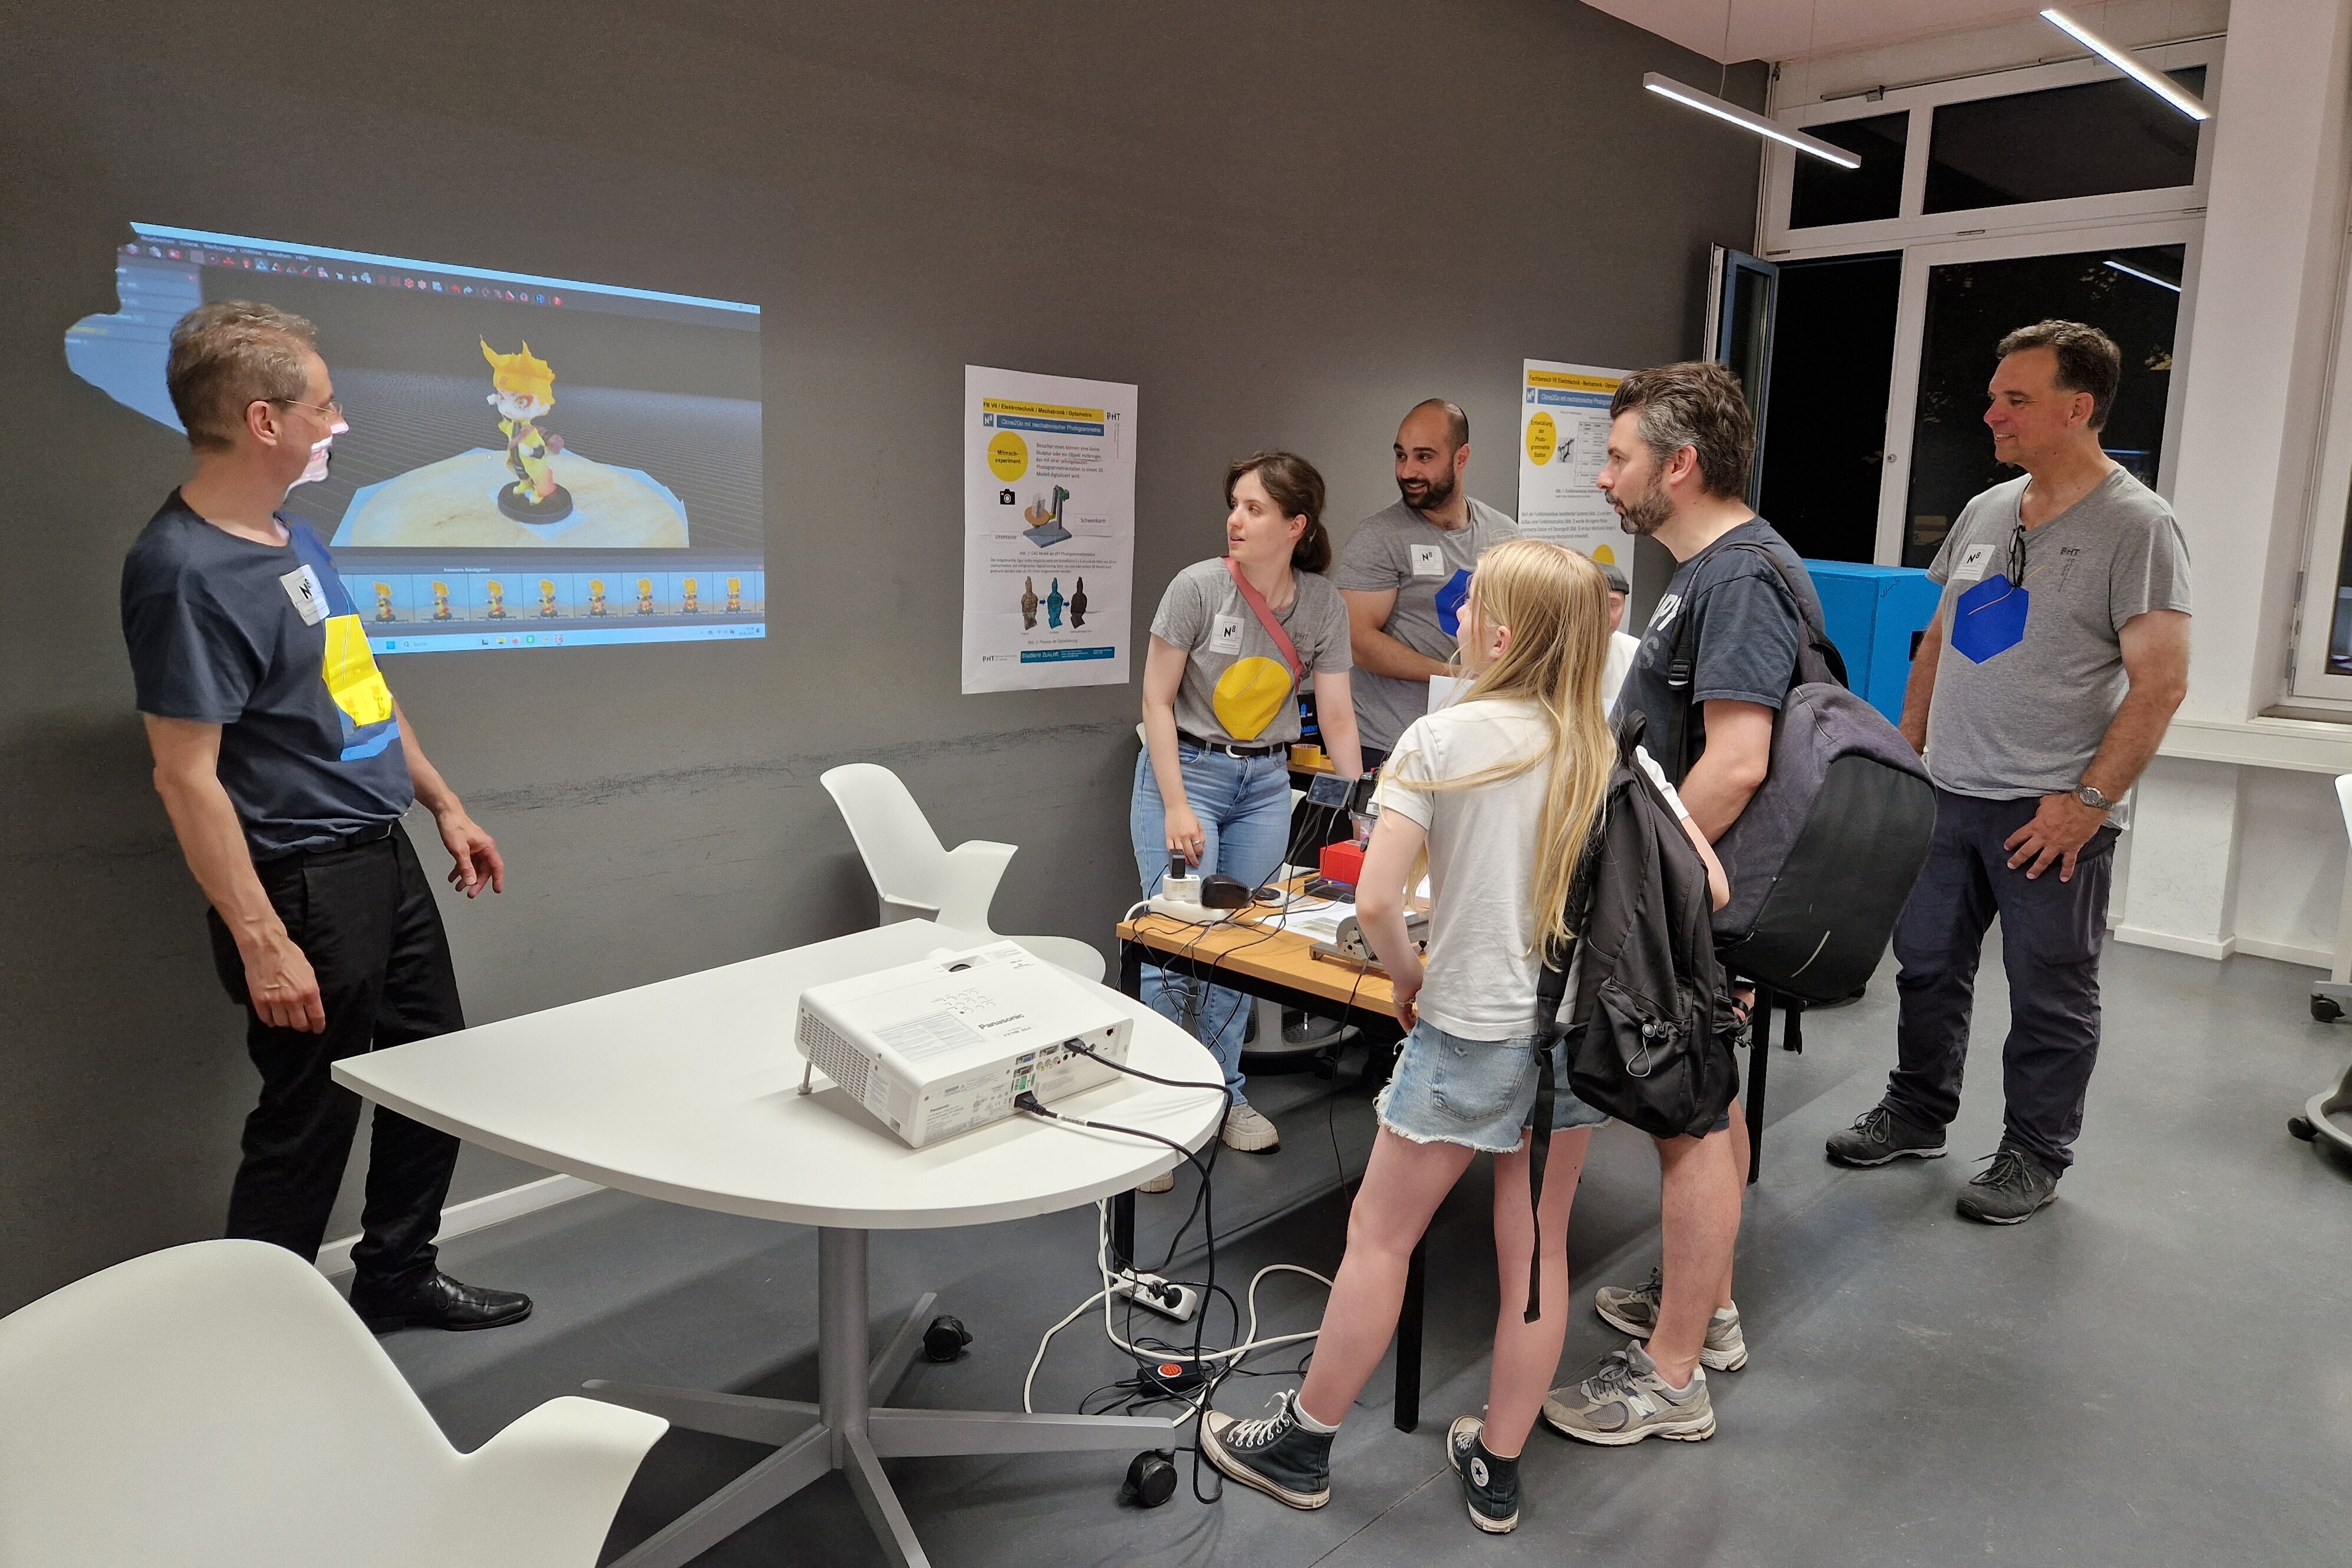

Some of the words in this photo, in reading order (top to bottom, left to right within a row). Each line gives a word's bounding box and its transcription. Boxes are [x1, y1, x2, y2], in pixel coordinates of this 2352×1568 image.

[1001, 404, 1035, 412] Elektrotechnik
[1038, 407, 1065, 415] Mechatronik
[1107, 412, 1121, 421] BHT
[1032, 422, 1066, 430] mechatronischer
[1067, 424, 1101, 433] Photogrammetrie
[2060, 547, 2081, 555] BHT
[977, 1014, 1025, 1029] Panasonic
